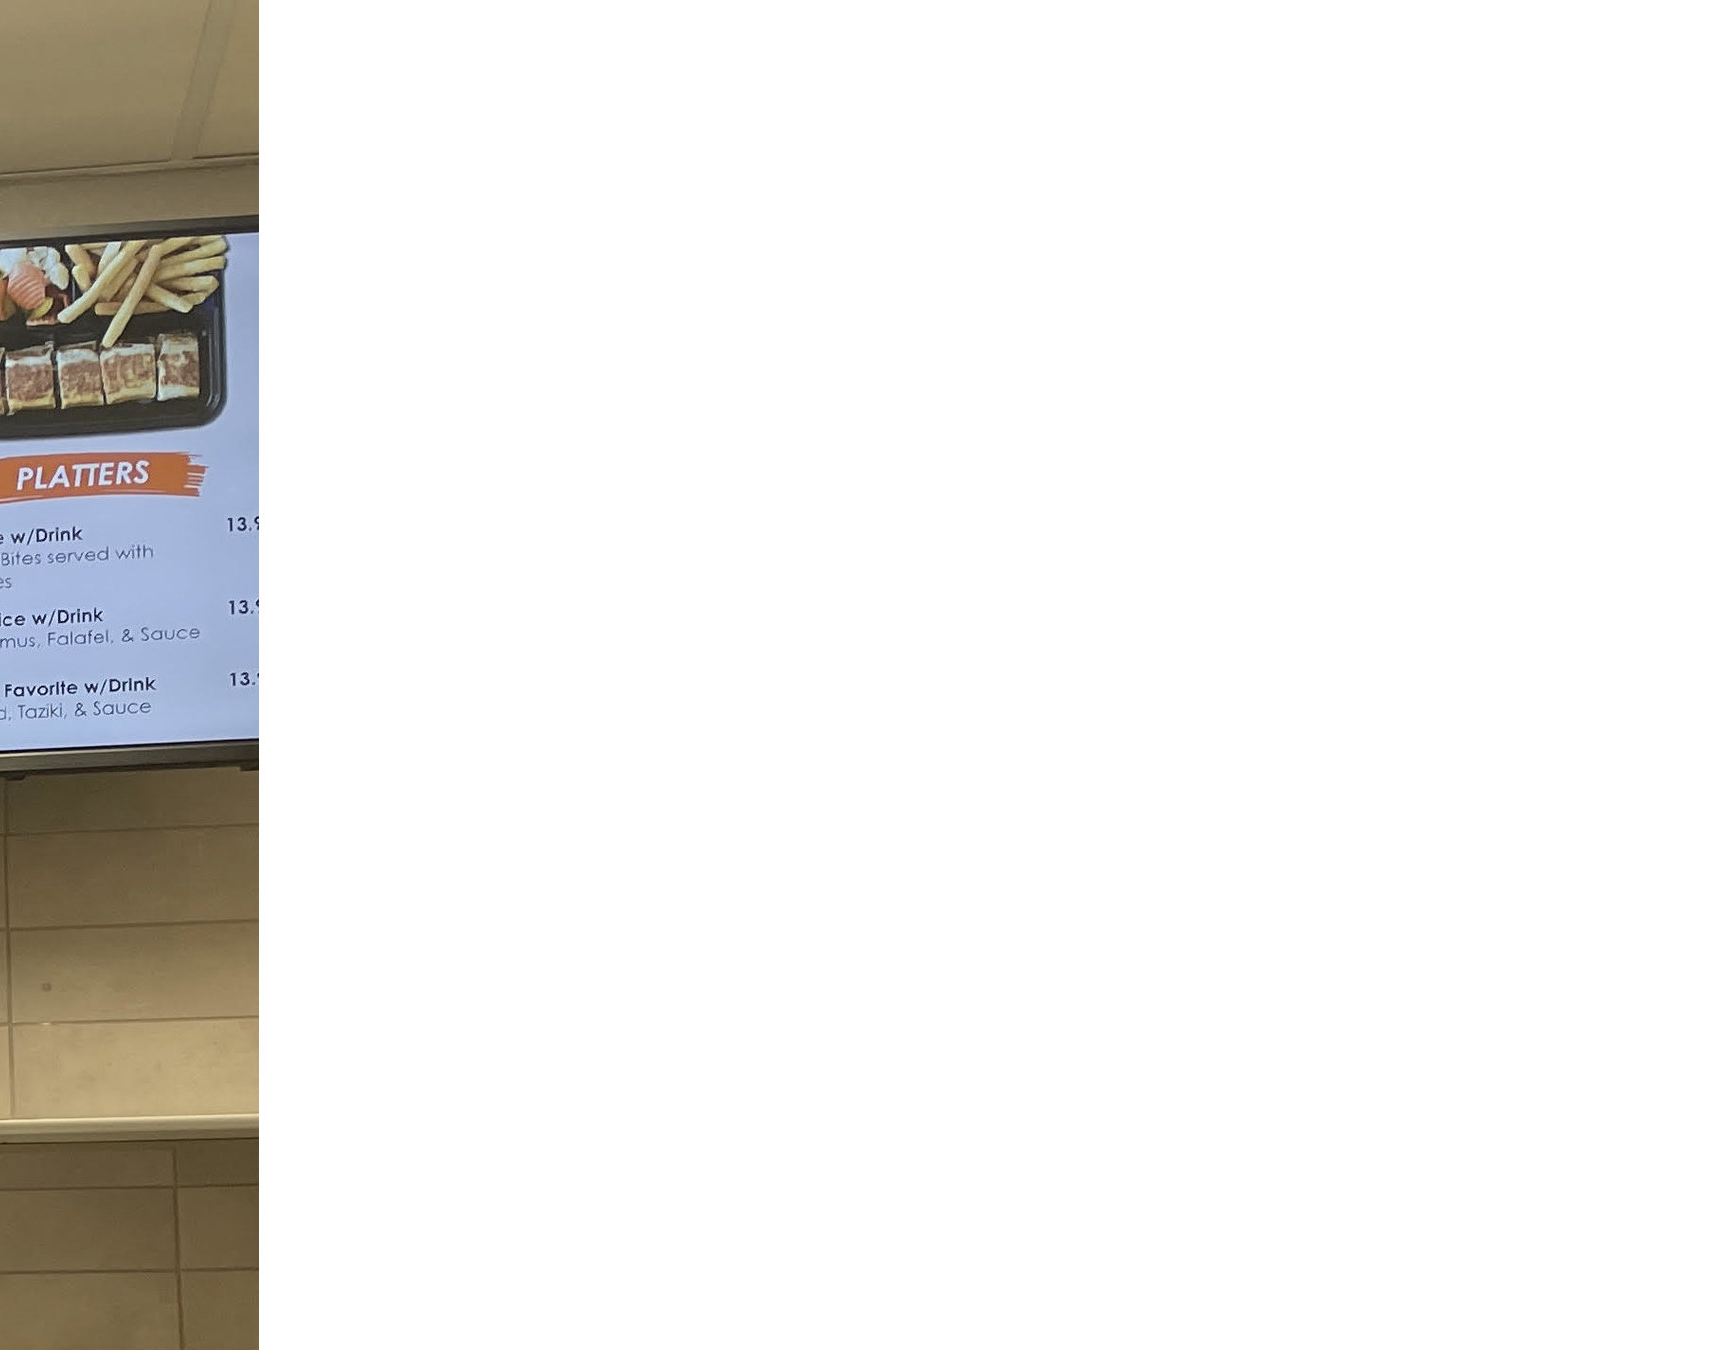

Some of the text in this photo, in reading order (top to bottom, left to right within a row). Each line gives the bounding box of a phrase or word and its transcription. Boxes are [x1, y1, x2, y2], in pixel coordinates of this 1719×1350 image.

[16, 460, 150, 491] PLATTERS
[10, 525, 83, 546] w/Drink
[1, 551, 42, 567] Bites
[47, 545, 109, 565] served
[115, 544, 154, 560] with
[31, 607, 104, 627] w/Drink
[47, 629, 114, 647] Falafel,
[140, 626, 201, 642] Sauce
[4, 680, 78, 698] Favorite
[84, 676, 157, 696] w/Drink
[17, 702, 67, 719] Taziki,
[92, 700, 152, 717] Sauce
